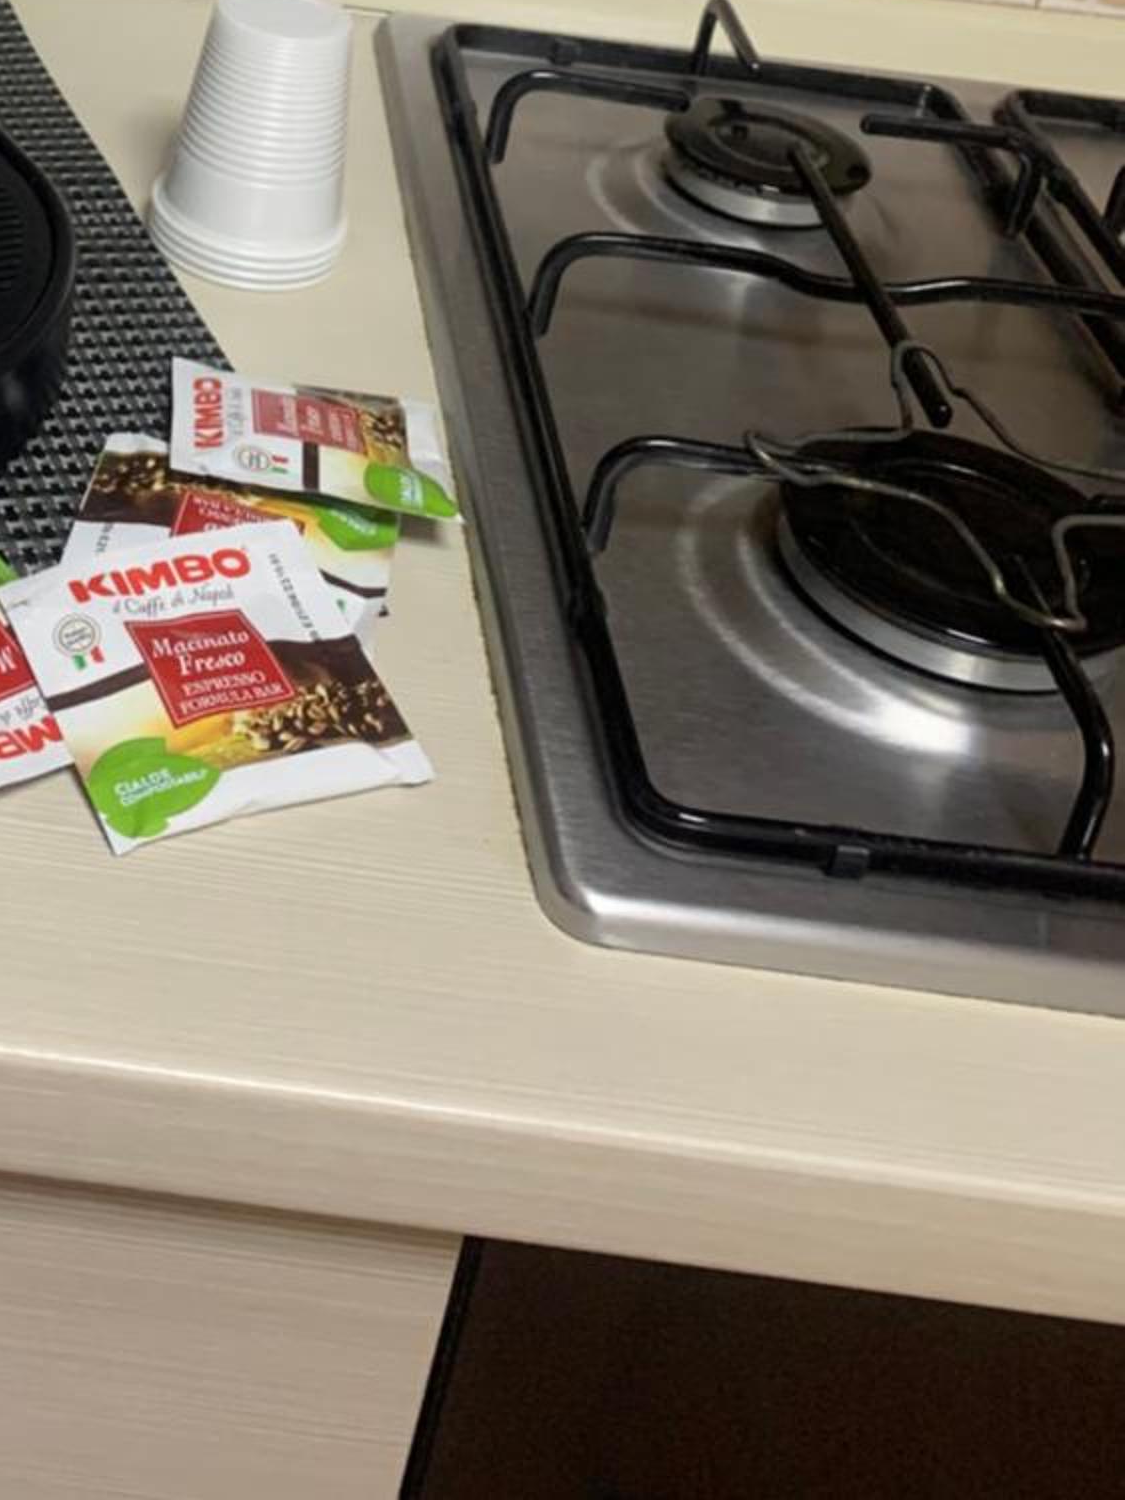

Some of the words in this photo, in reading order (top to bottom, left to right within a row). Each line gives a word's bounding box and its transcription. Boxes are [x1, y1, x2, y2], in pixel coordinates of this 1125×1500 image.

[192, 376, 225, 449] KIMBO
[68, 548, 252, 604] KIMBO
[150, 629, 251, 661] Macinato
[177, 650, 248, 677] Fresco
[179, 688, 254, 716] FORMULA
[250, 683, 284, 702] BAR
[181, 670, 267, 698] ESPRESSO
